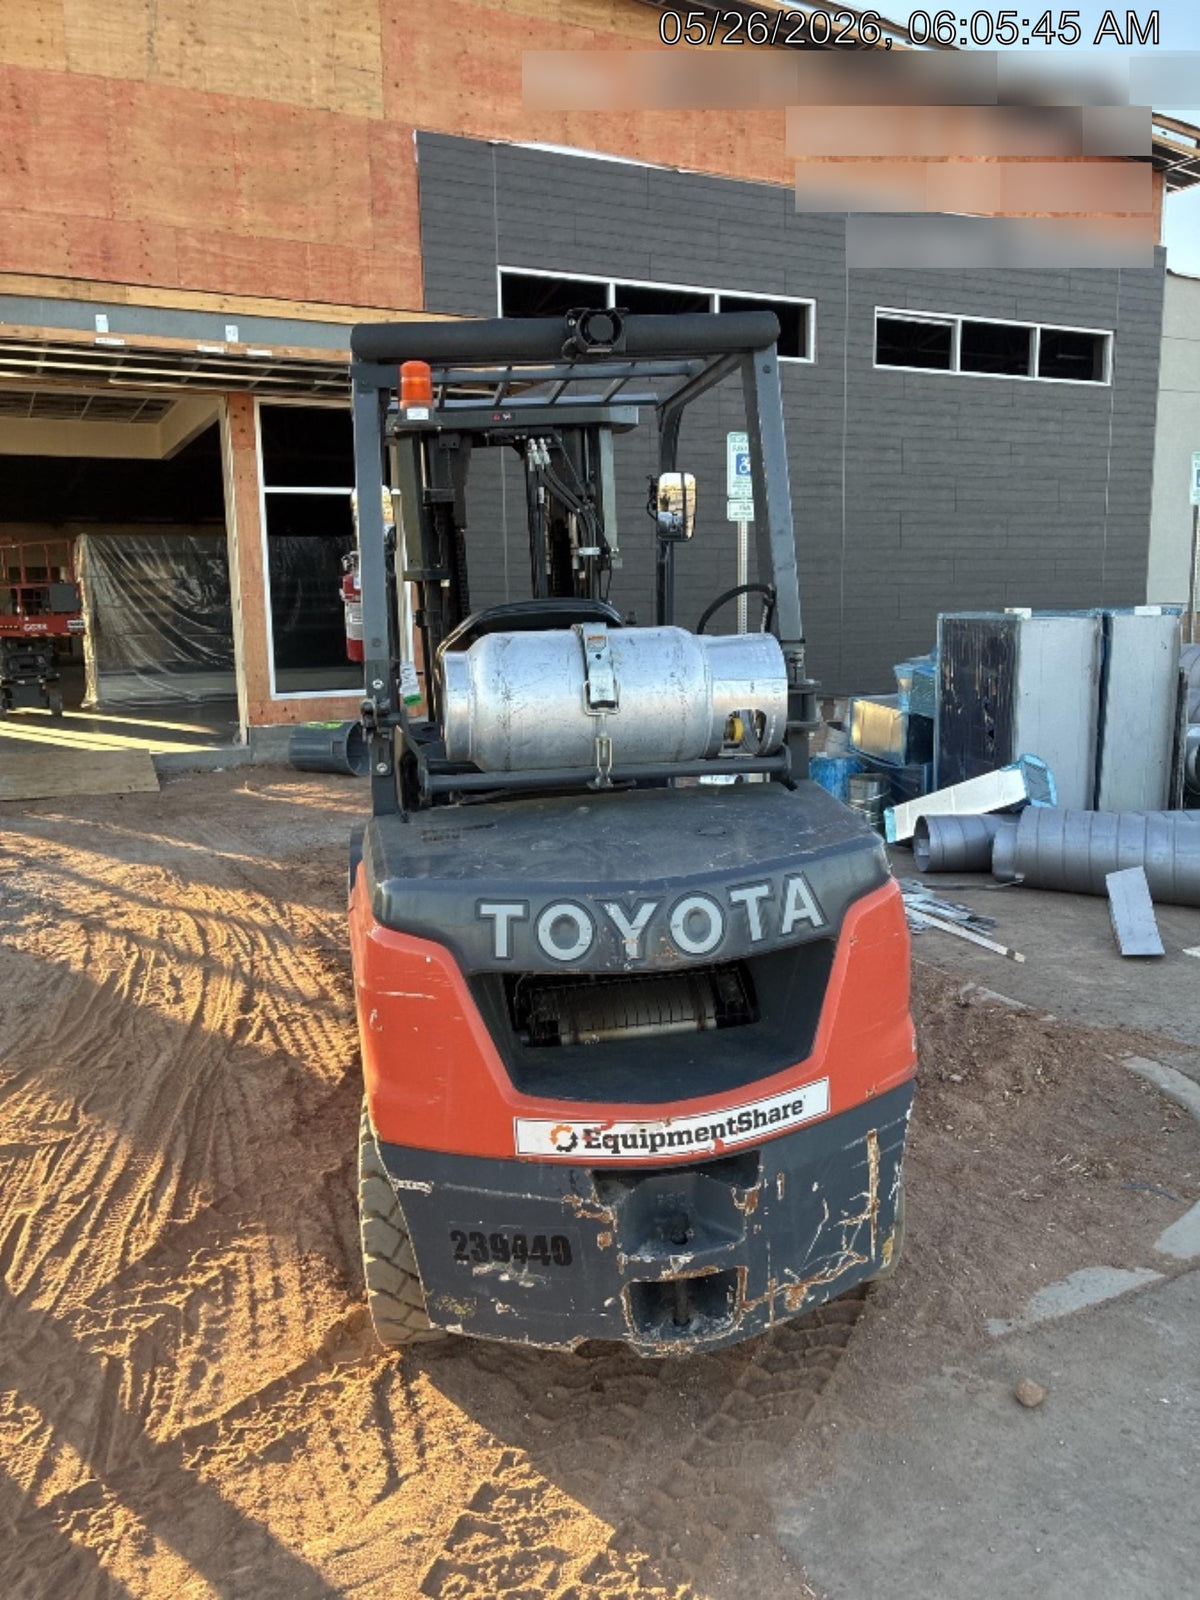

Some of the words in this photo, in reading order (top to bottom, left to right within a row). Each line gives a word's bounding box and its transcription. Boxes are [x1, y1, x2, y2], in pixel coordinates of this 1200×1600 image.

[479, 877, 825, 961] TOYOTA
[583, 1099, 804, 1154] EquipmentShare
[450, 1230, 573, 1266] 239440
